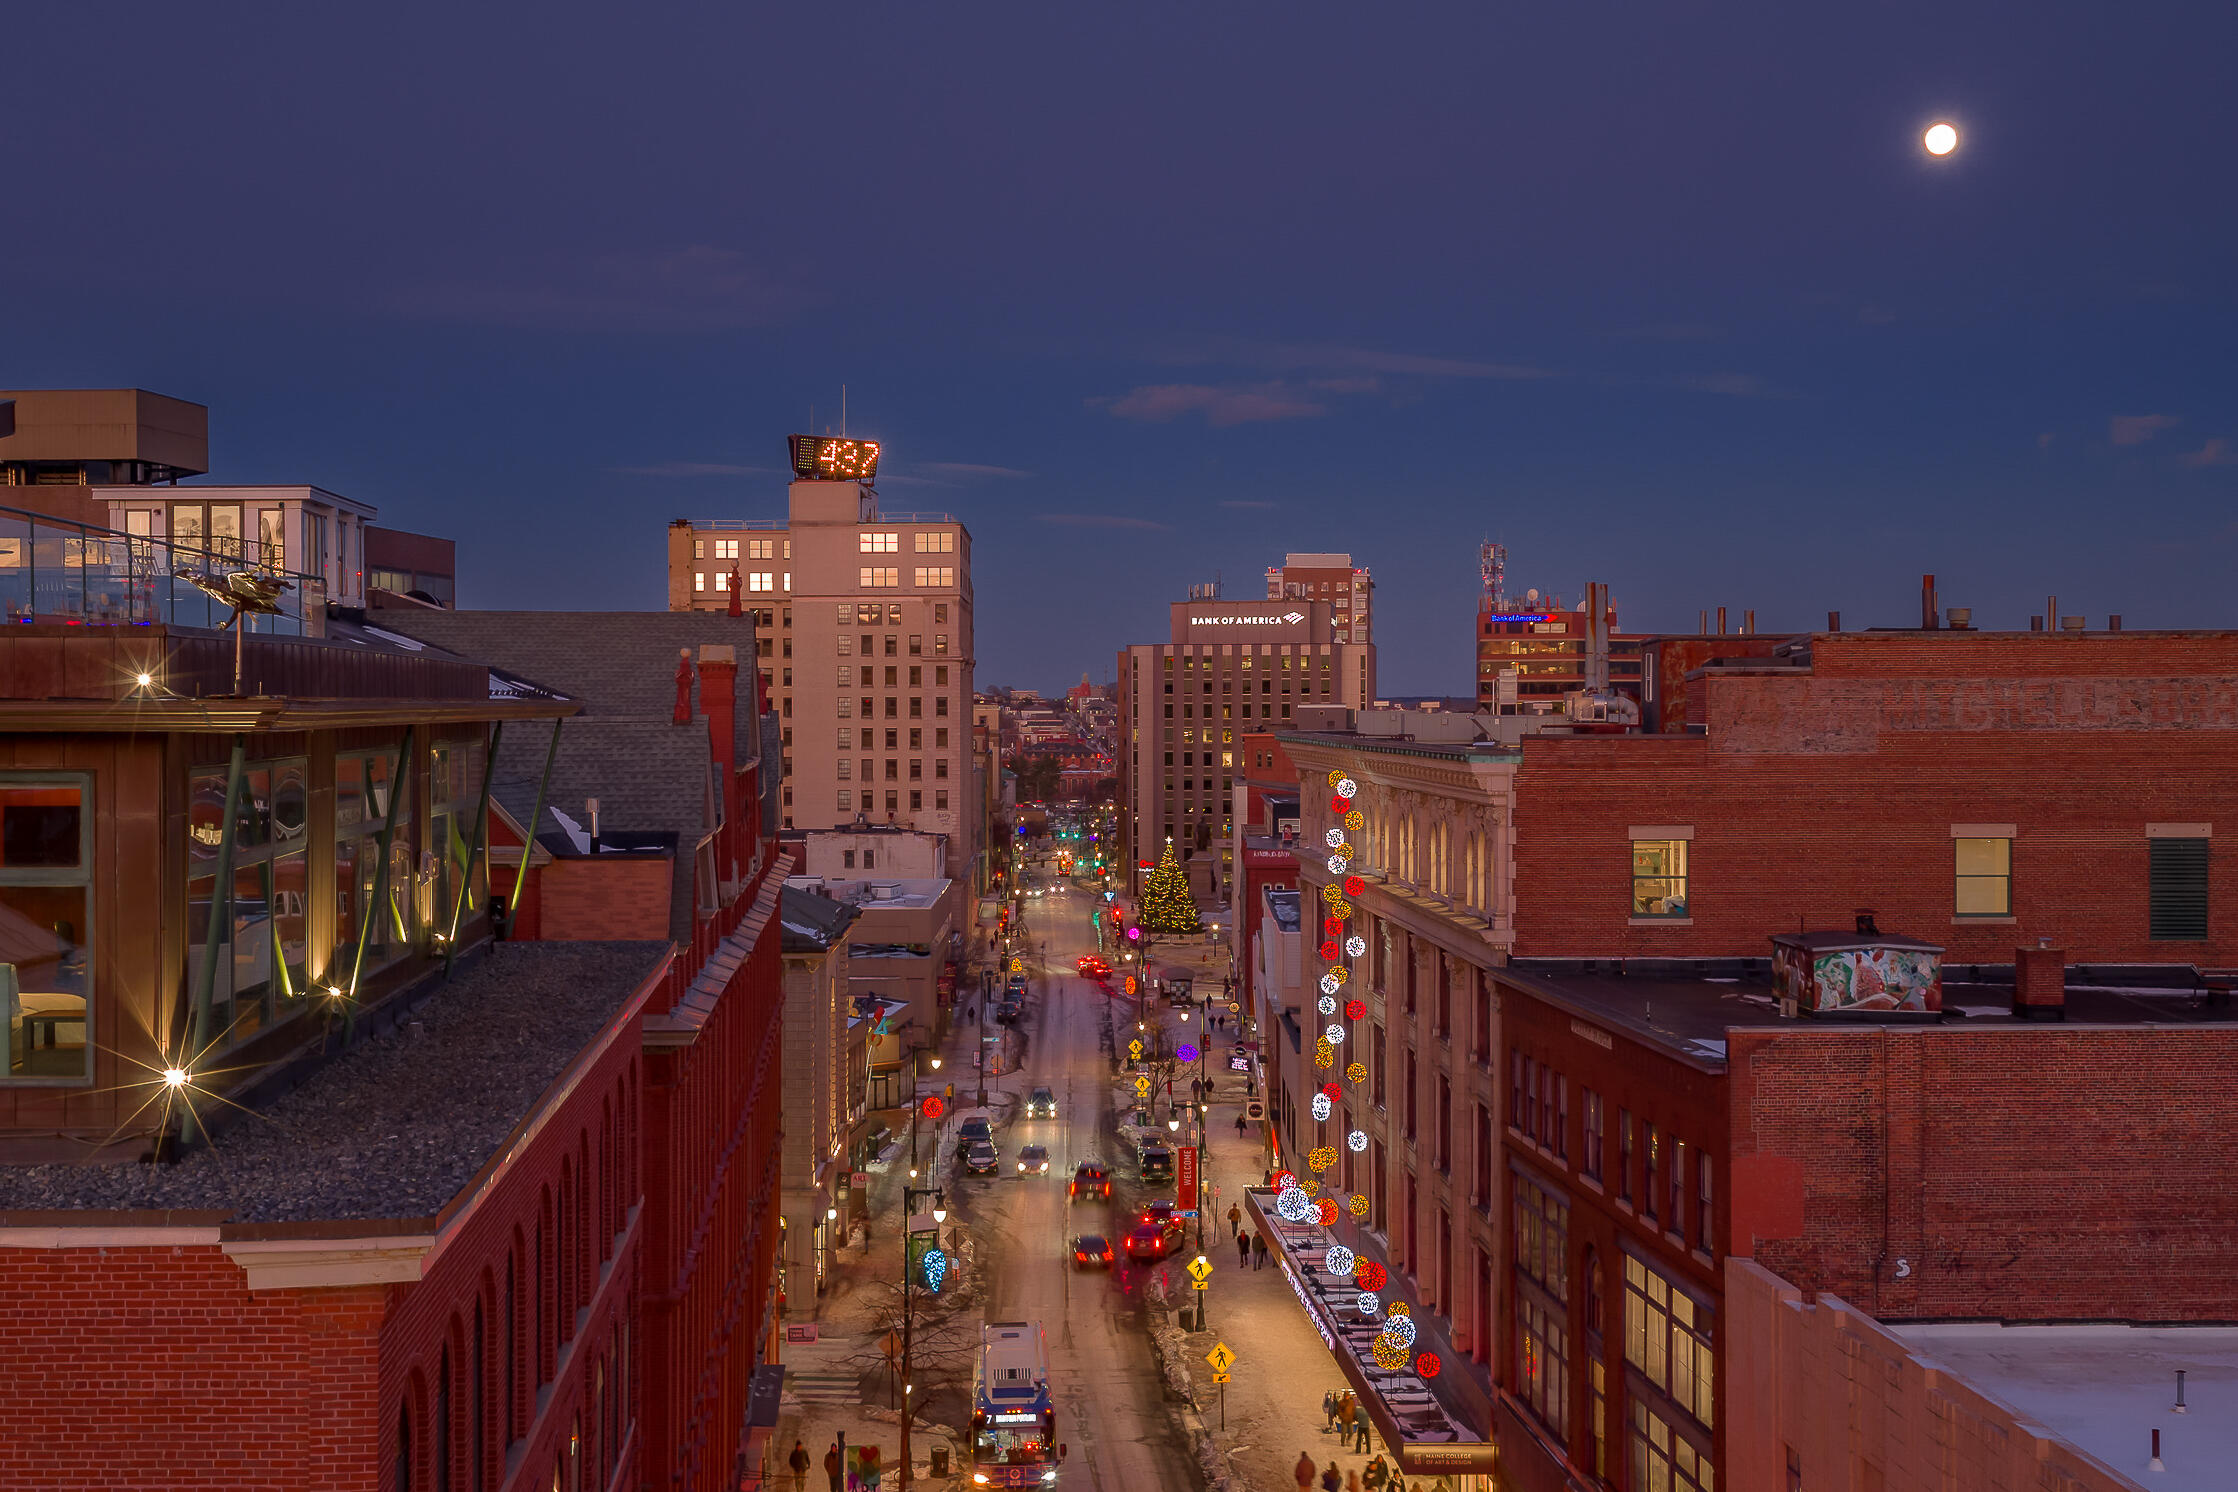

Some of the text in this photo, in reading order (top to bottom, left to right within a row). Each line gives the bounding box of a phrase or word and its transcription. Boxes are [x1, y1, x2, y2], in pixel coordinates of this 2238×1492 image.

[1191, 616, 1282, 625] BANK OF AMERICA
[1515, 614, 1542, 622] America
[1183, 1150, 1192, 1186] WELCOME
[986, 1414, 992, 1424] 7
